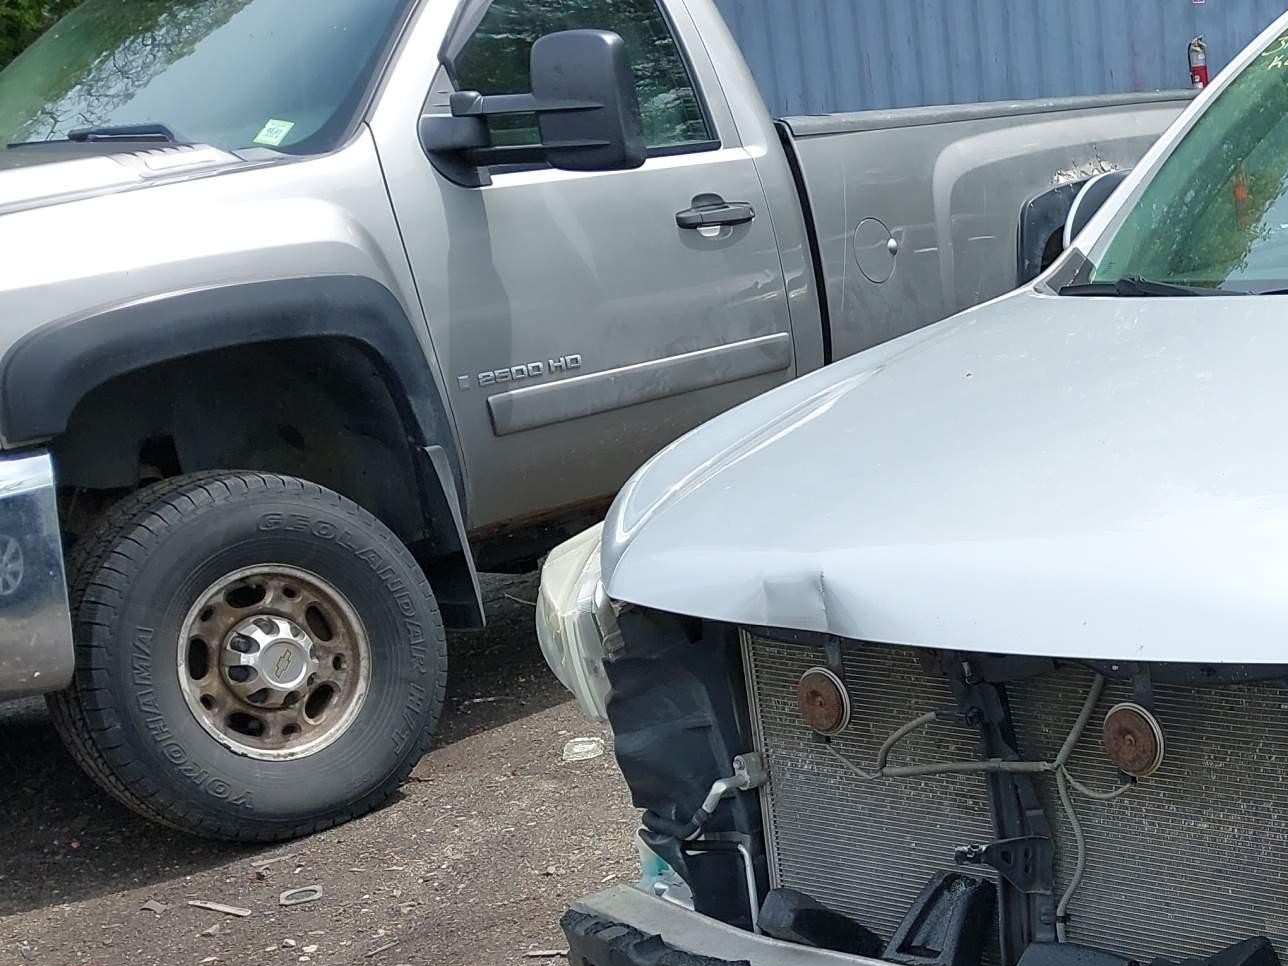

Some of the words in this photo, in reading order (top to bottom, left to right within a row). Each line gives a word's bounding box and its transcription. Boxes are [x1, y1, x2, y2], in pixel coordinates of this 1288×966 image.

[478, 361, 543, 386] 2500
[548, 354, 581, 374] HD
[256, 512, 426, 675] GEOLANDAR
[132, 626, 254, 808] YOKOHAMA
